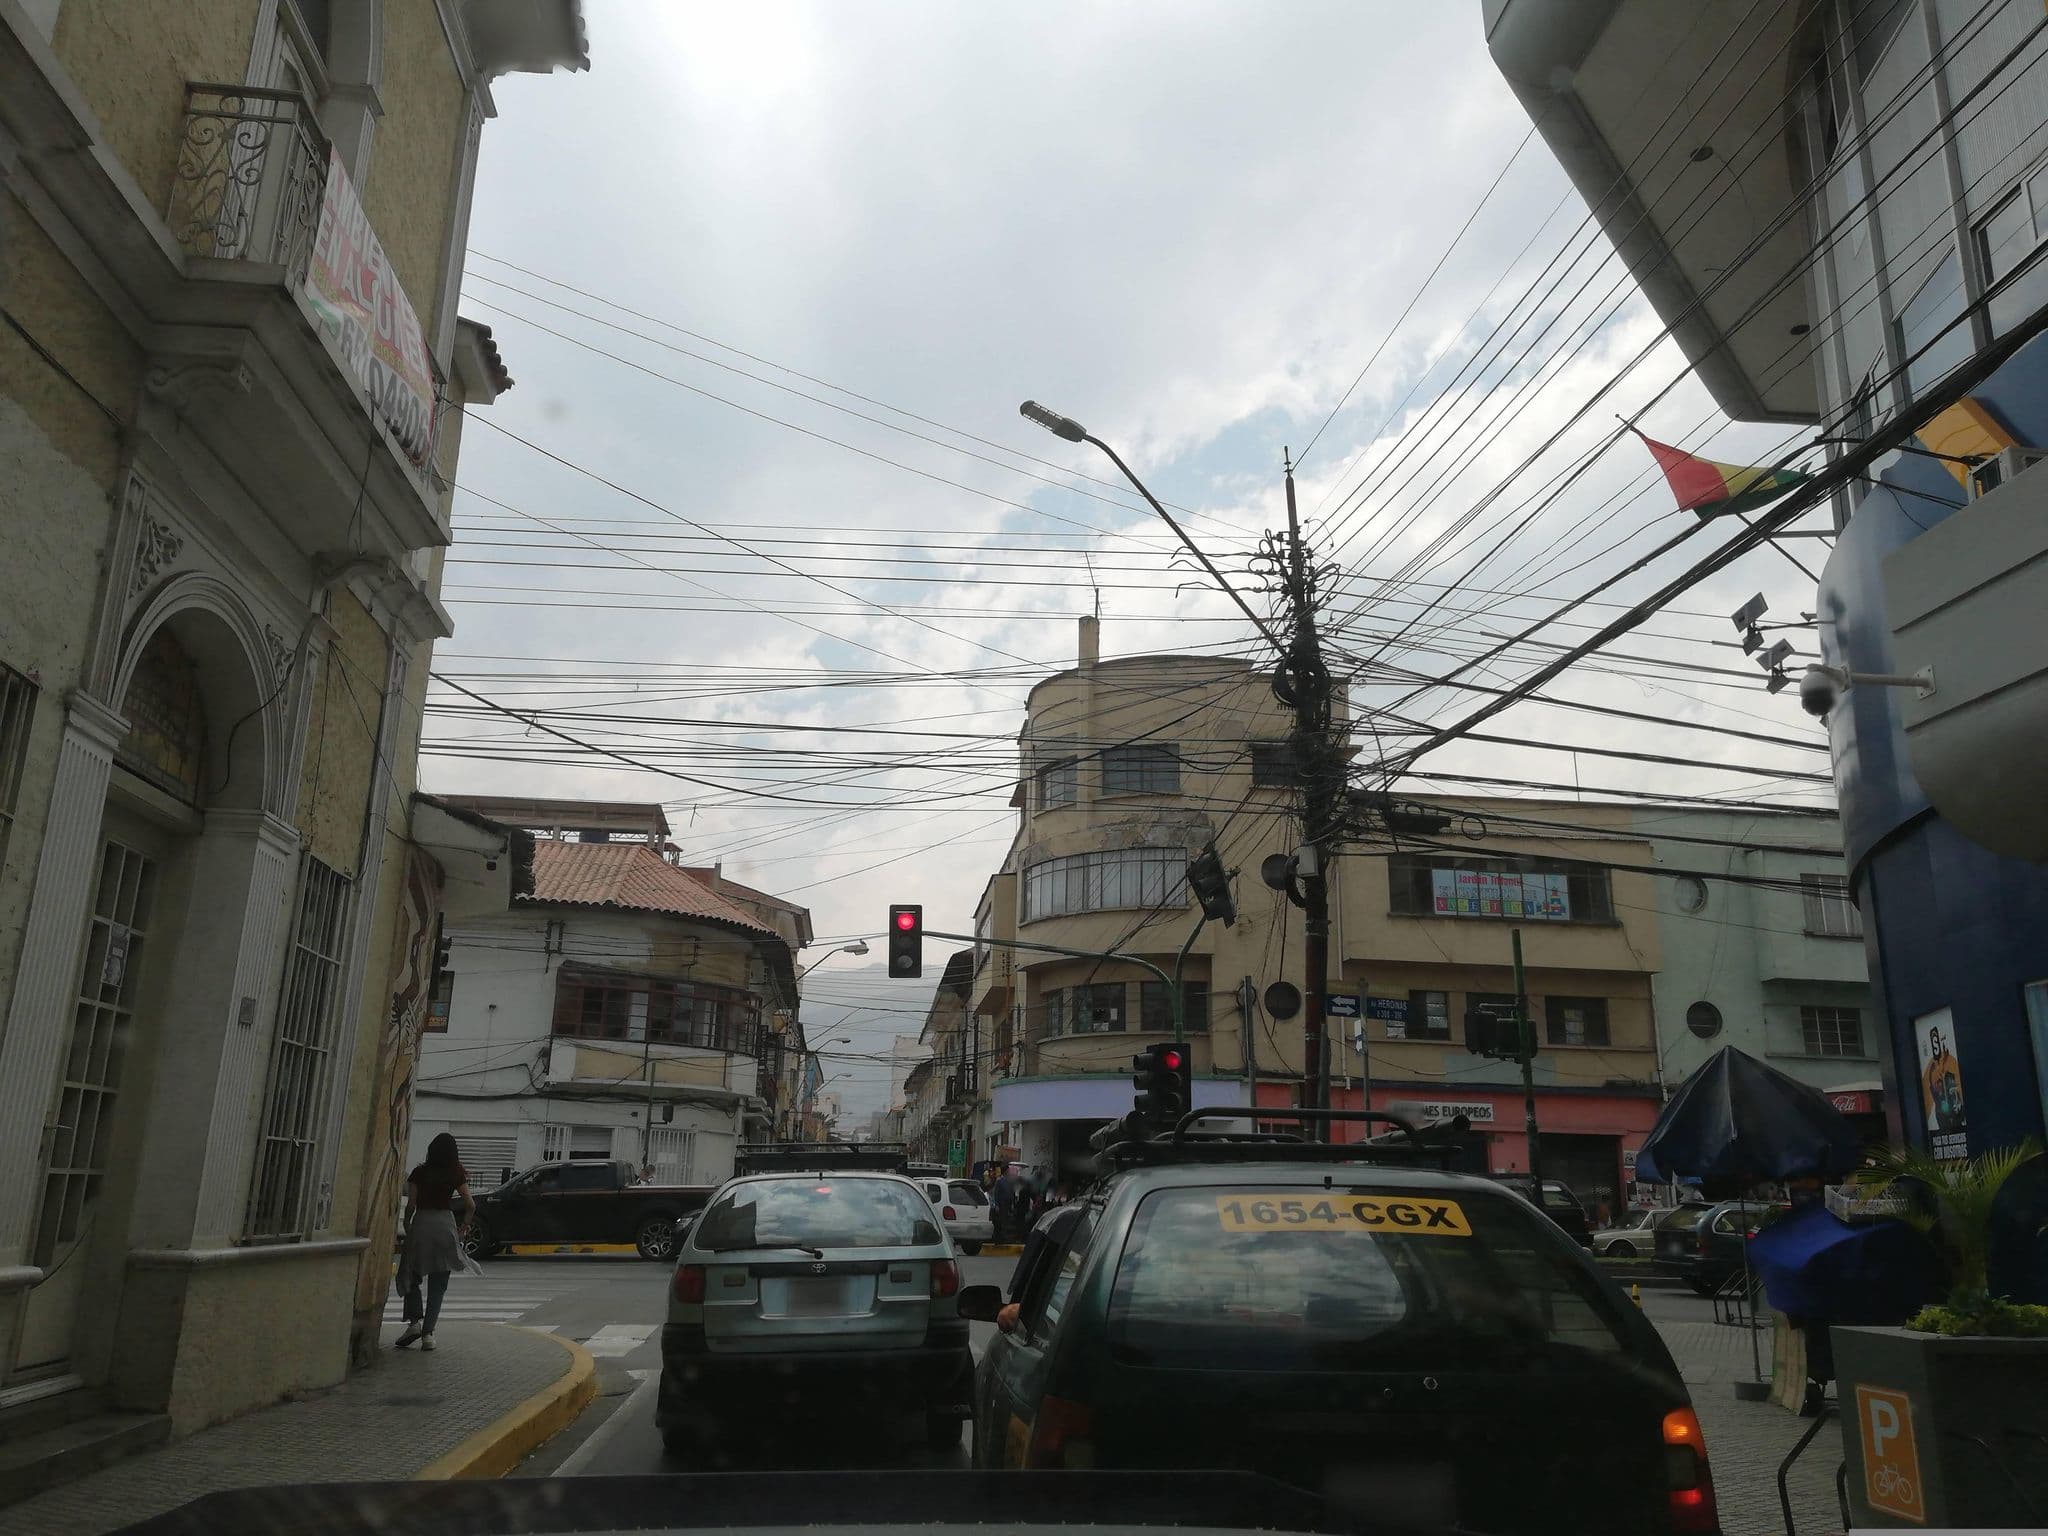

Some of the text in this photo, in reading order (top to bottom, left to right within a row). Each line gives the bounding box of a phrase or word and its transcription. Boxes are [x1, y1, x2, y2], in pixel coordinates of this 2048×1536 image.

[1442, 1105, 1491, 1118] EUROPEOS
[1223, 1201, 1459, 1230] 1654-CGX
[1869, 1398, 1900, 1457] P
